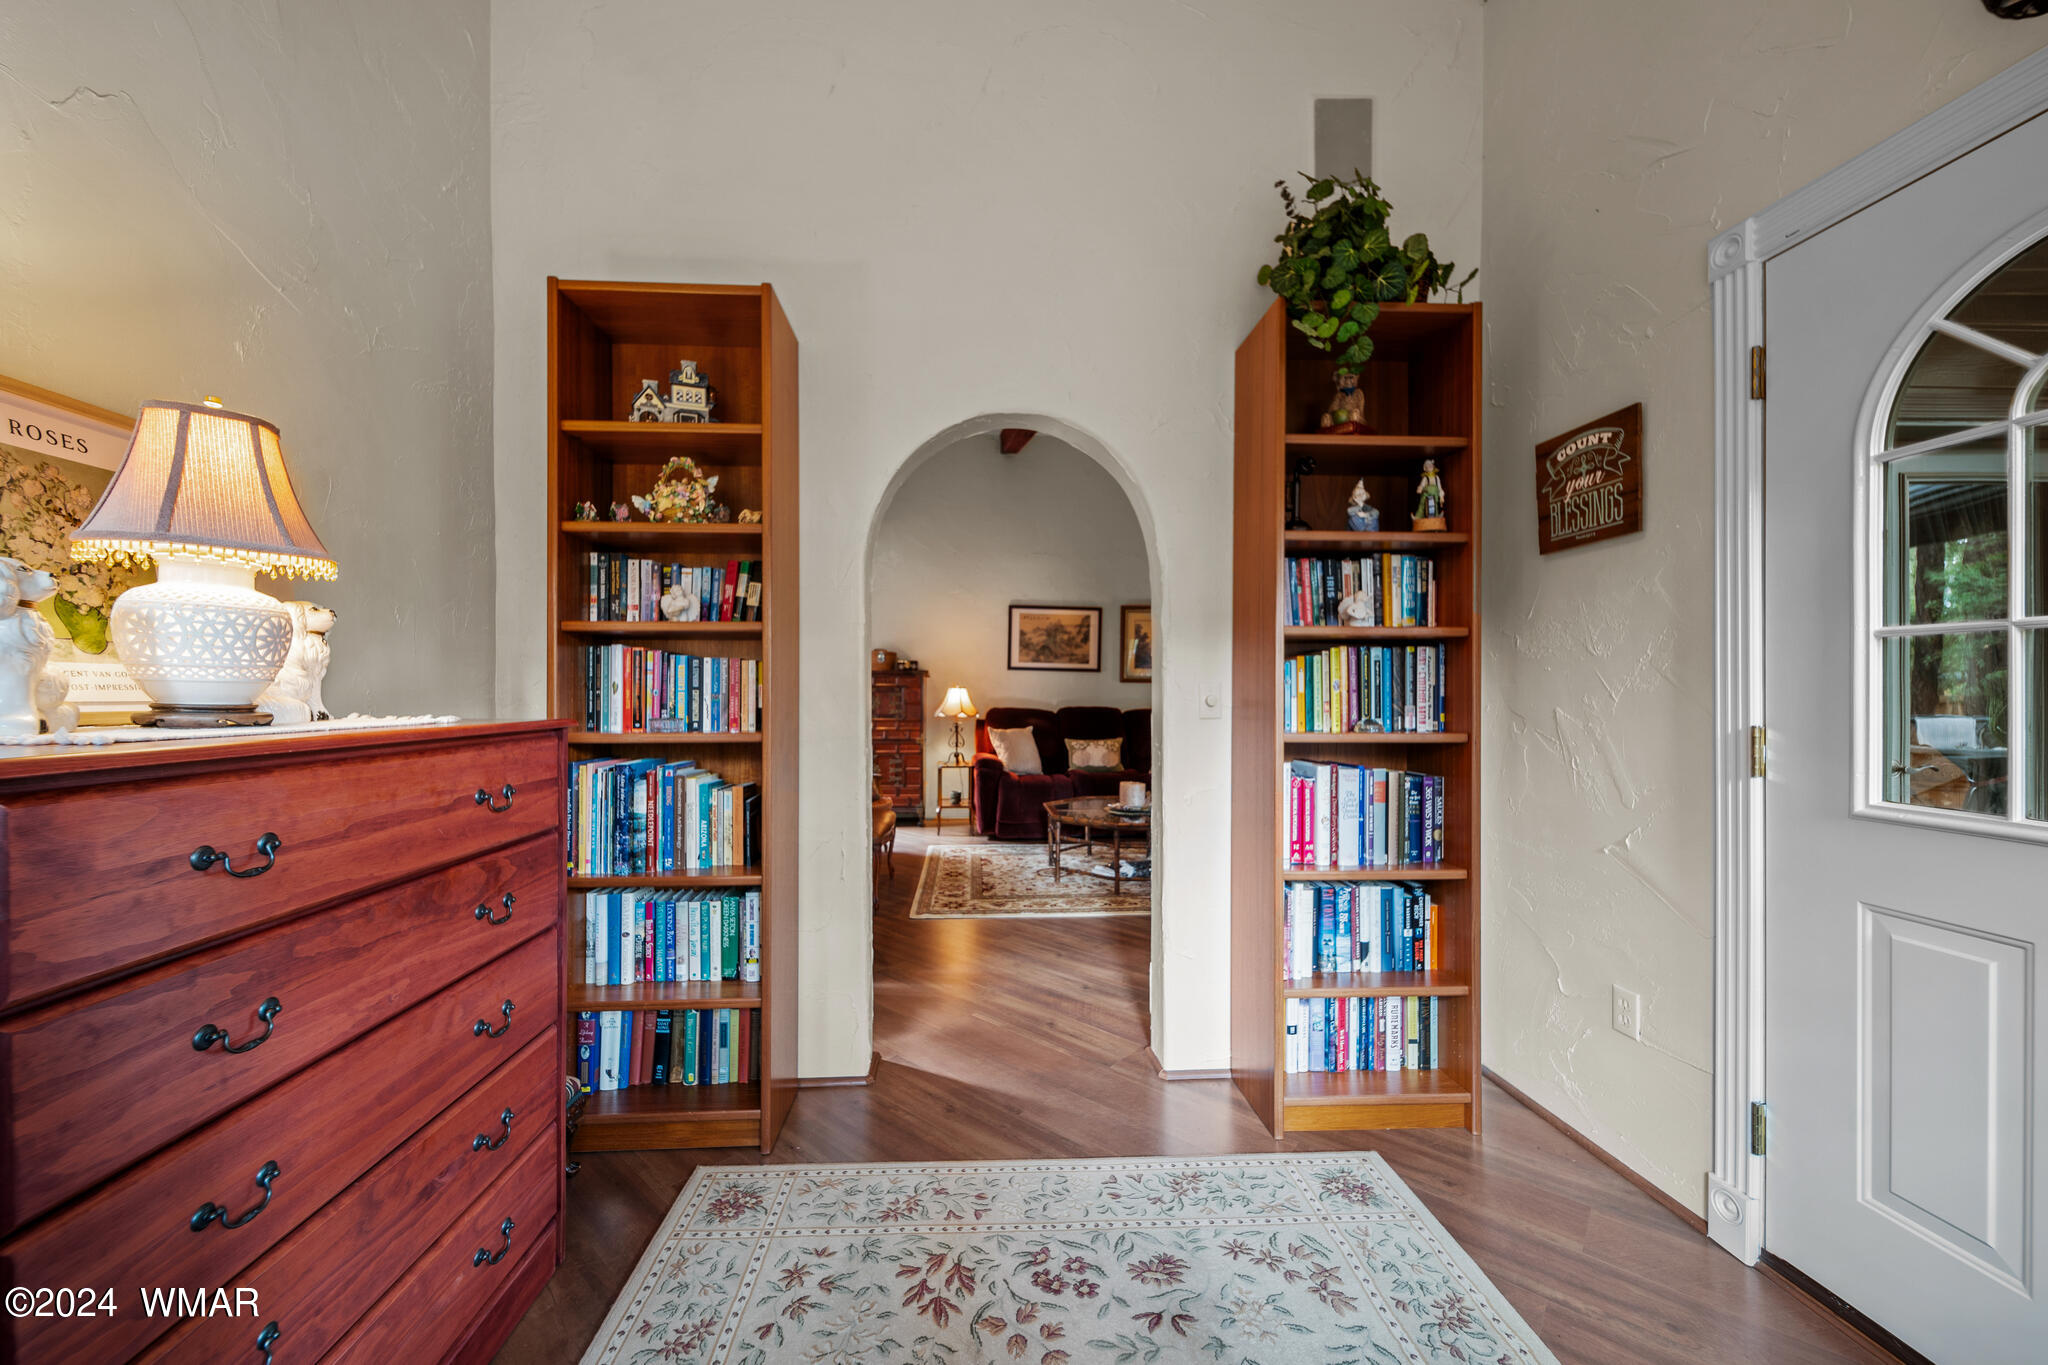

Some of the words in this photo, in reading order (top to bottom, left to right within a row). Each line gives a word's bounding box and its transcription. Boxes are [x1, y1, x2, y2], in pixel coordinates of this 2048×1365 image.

[8, 418, 88, 454] ROSES
[1556, 432, 1612, 462] COUNT
[1564, 470, 1605, 502] your
[1550, 483, 1624, 537] BLESSINGS
[1327, 576, 1335, 598] IRIS
[1425, 819, 1432, 828] TO
